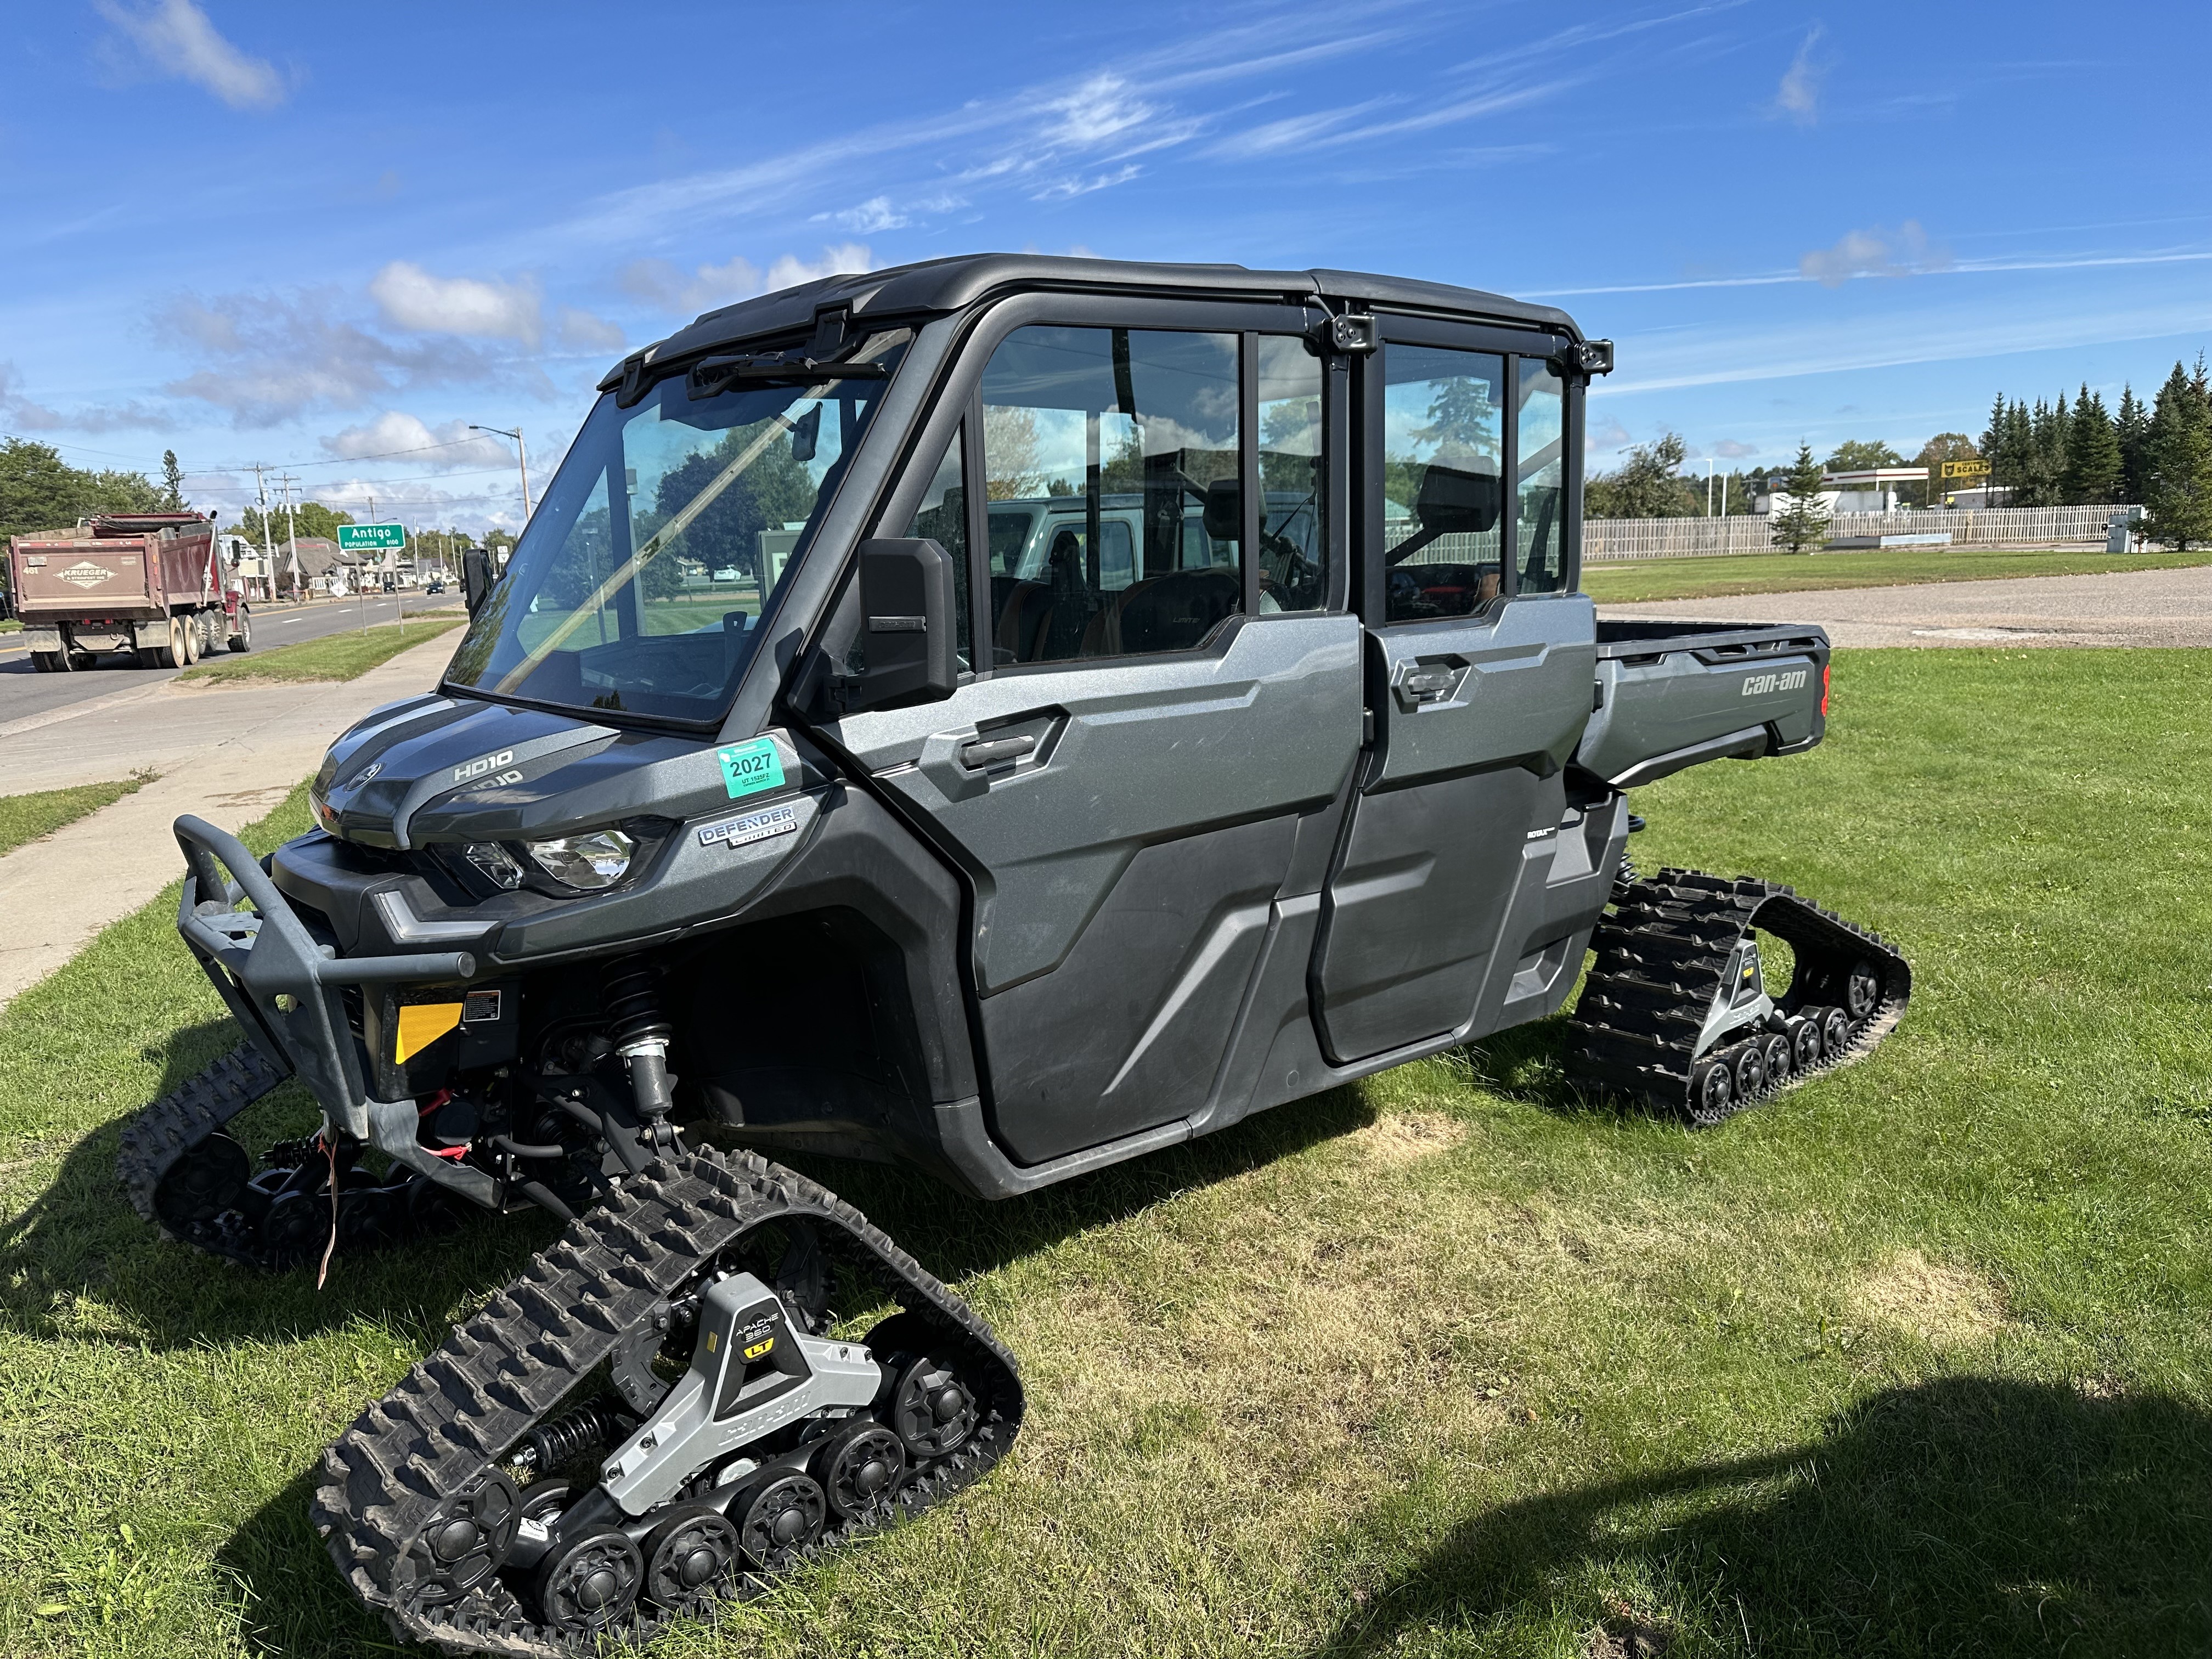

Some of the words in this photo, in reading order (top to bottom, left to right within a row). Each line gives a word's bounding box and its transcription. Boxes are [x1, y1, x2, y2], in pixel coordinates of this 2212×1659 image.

[352, 528, 391, 540] Antigo
[1741, 670, 1807, 696] can-am
[454, 750, 513, 781] HD10
[730, 753, 771, 777] 2027
[702, 809, 792, 841] DEFENDER
[1527, 829, 1548, 839] ROTAX
[736, 1312, 779, 1336] APACHE
[745, 1325, 771, 1341] 360
[751, 1341, 769, 1356] LT
